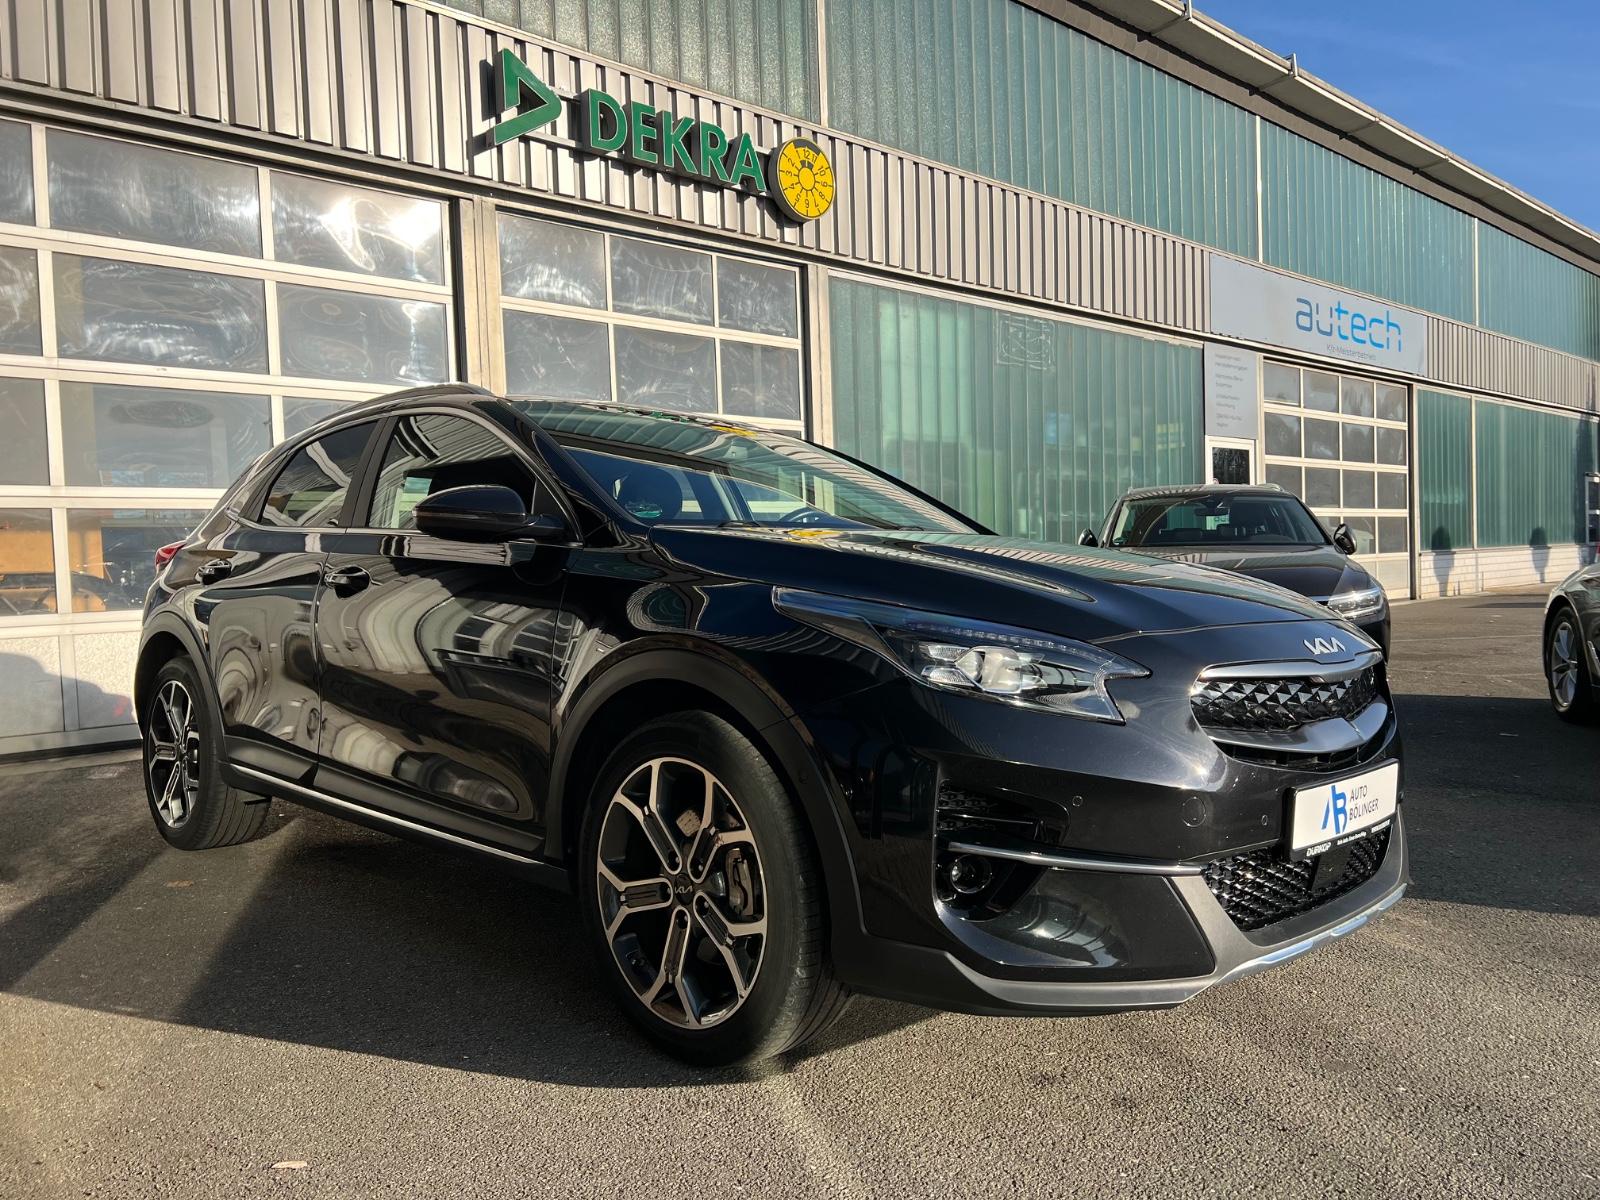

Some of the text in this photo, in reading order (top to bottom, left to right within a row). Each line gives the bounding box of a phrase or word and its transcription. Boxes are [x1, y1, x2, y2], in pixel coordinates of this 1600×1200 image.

[588, 88, 766, 192] DEKRA
[803, 149, 811, 160] 12
[788, 158, 795, 167] 2
[818, 166, 826, 177] 10
[795, 194, 801, 203] 5
[819, 192, 826, 200] 8
[804, 199, 810, 208] 6
[1295, 297, 1402, 353] autech
[1303, 637, 1346, 655] KIA
[1349, 785, 1368, 802] AUTO
[1349, 798, 1379, 821] BÖLINGER
